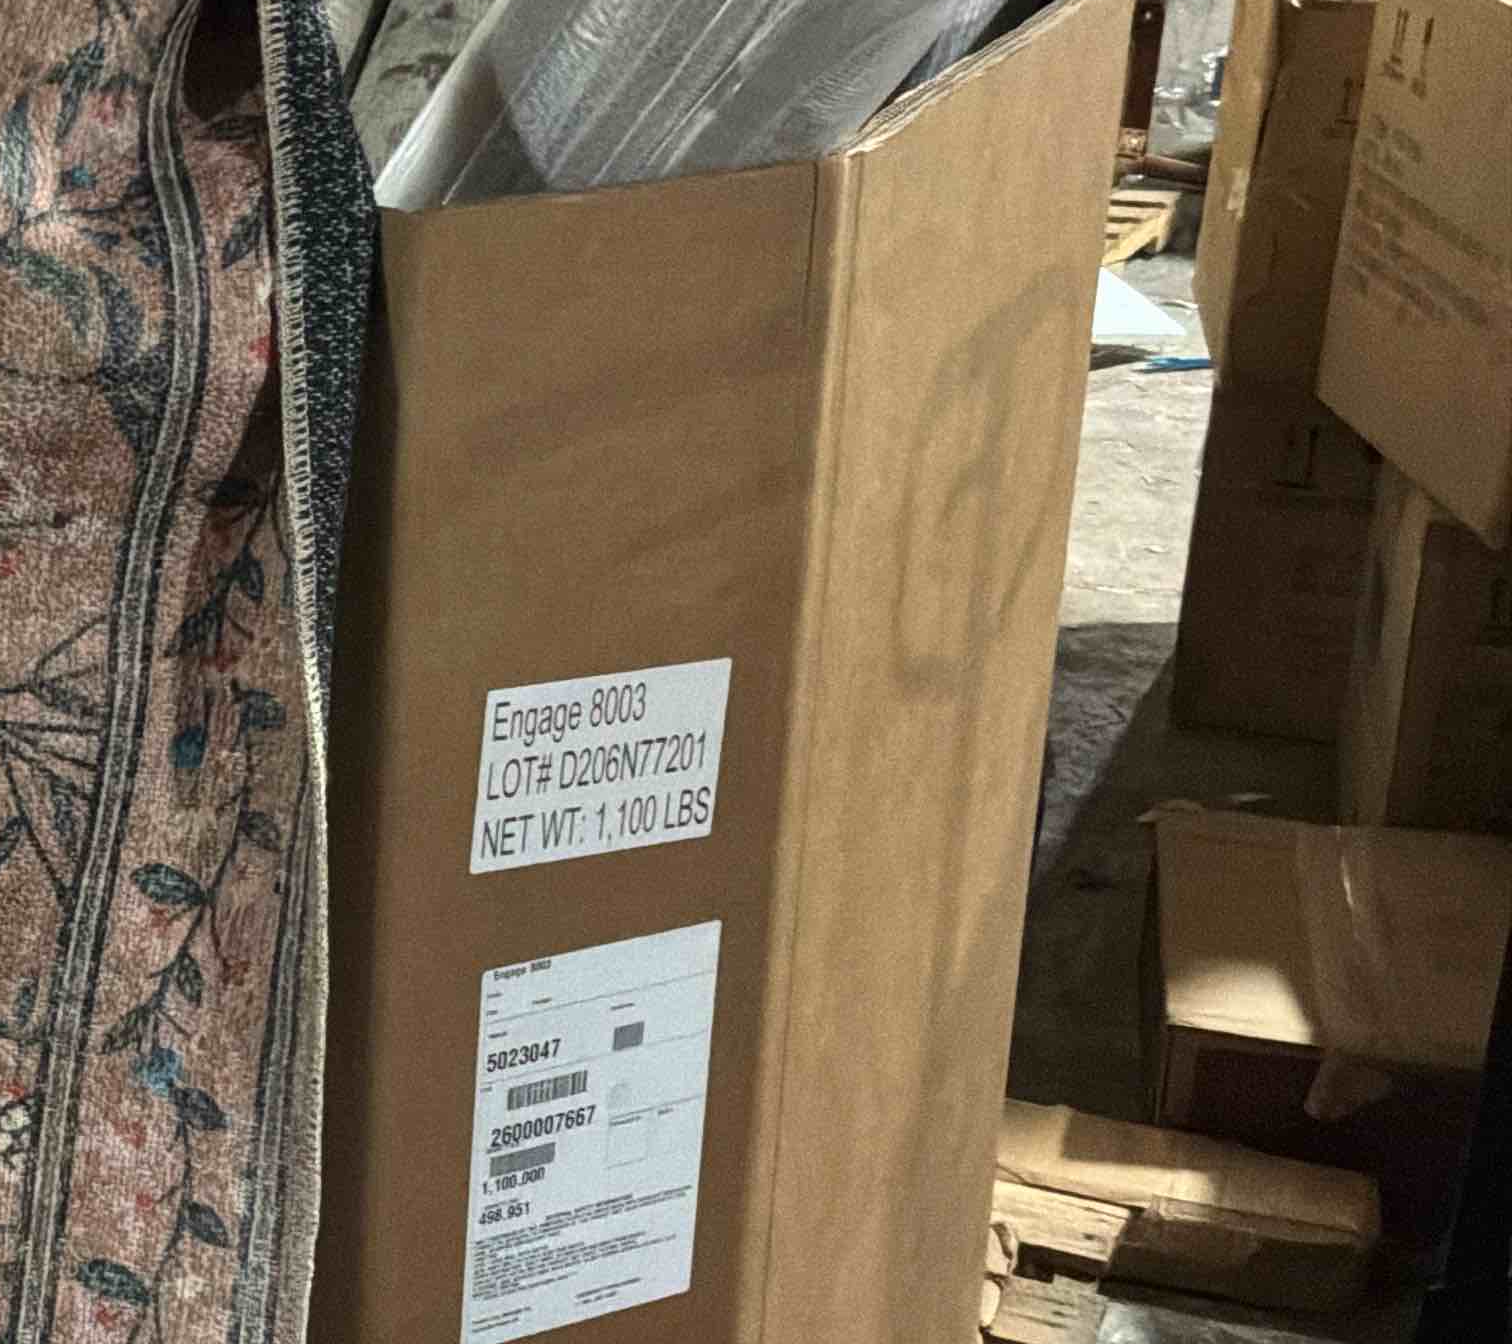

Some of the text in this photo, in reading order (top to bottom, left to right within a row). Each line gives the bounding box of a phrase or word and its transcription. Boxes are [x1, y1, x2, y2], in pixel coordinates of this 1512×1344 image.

[491, 681, 648, 748] Engage 8003
[485, 728, 707, 801] LOT# D206N77201
[480, 813, 535, 860] NET
[541, 805, 587, 850] WT:
[663, 785, 712, 830] LBS
[486, 1037, 562, 1074] 5023047
[489, 1103, 598, 1149] 2600007667
[481, 1166, 547, 1197] 1,100.000
[478, 1200, 532, 1227] 498.951
